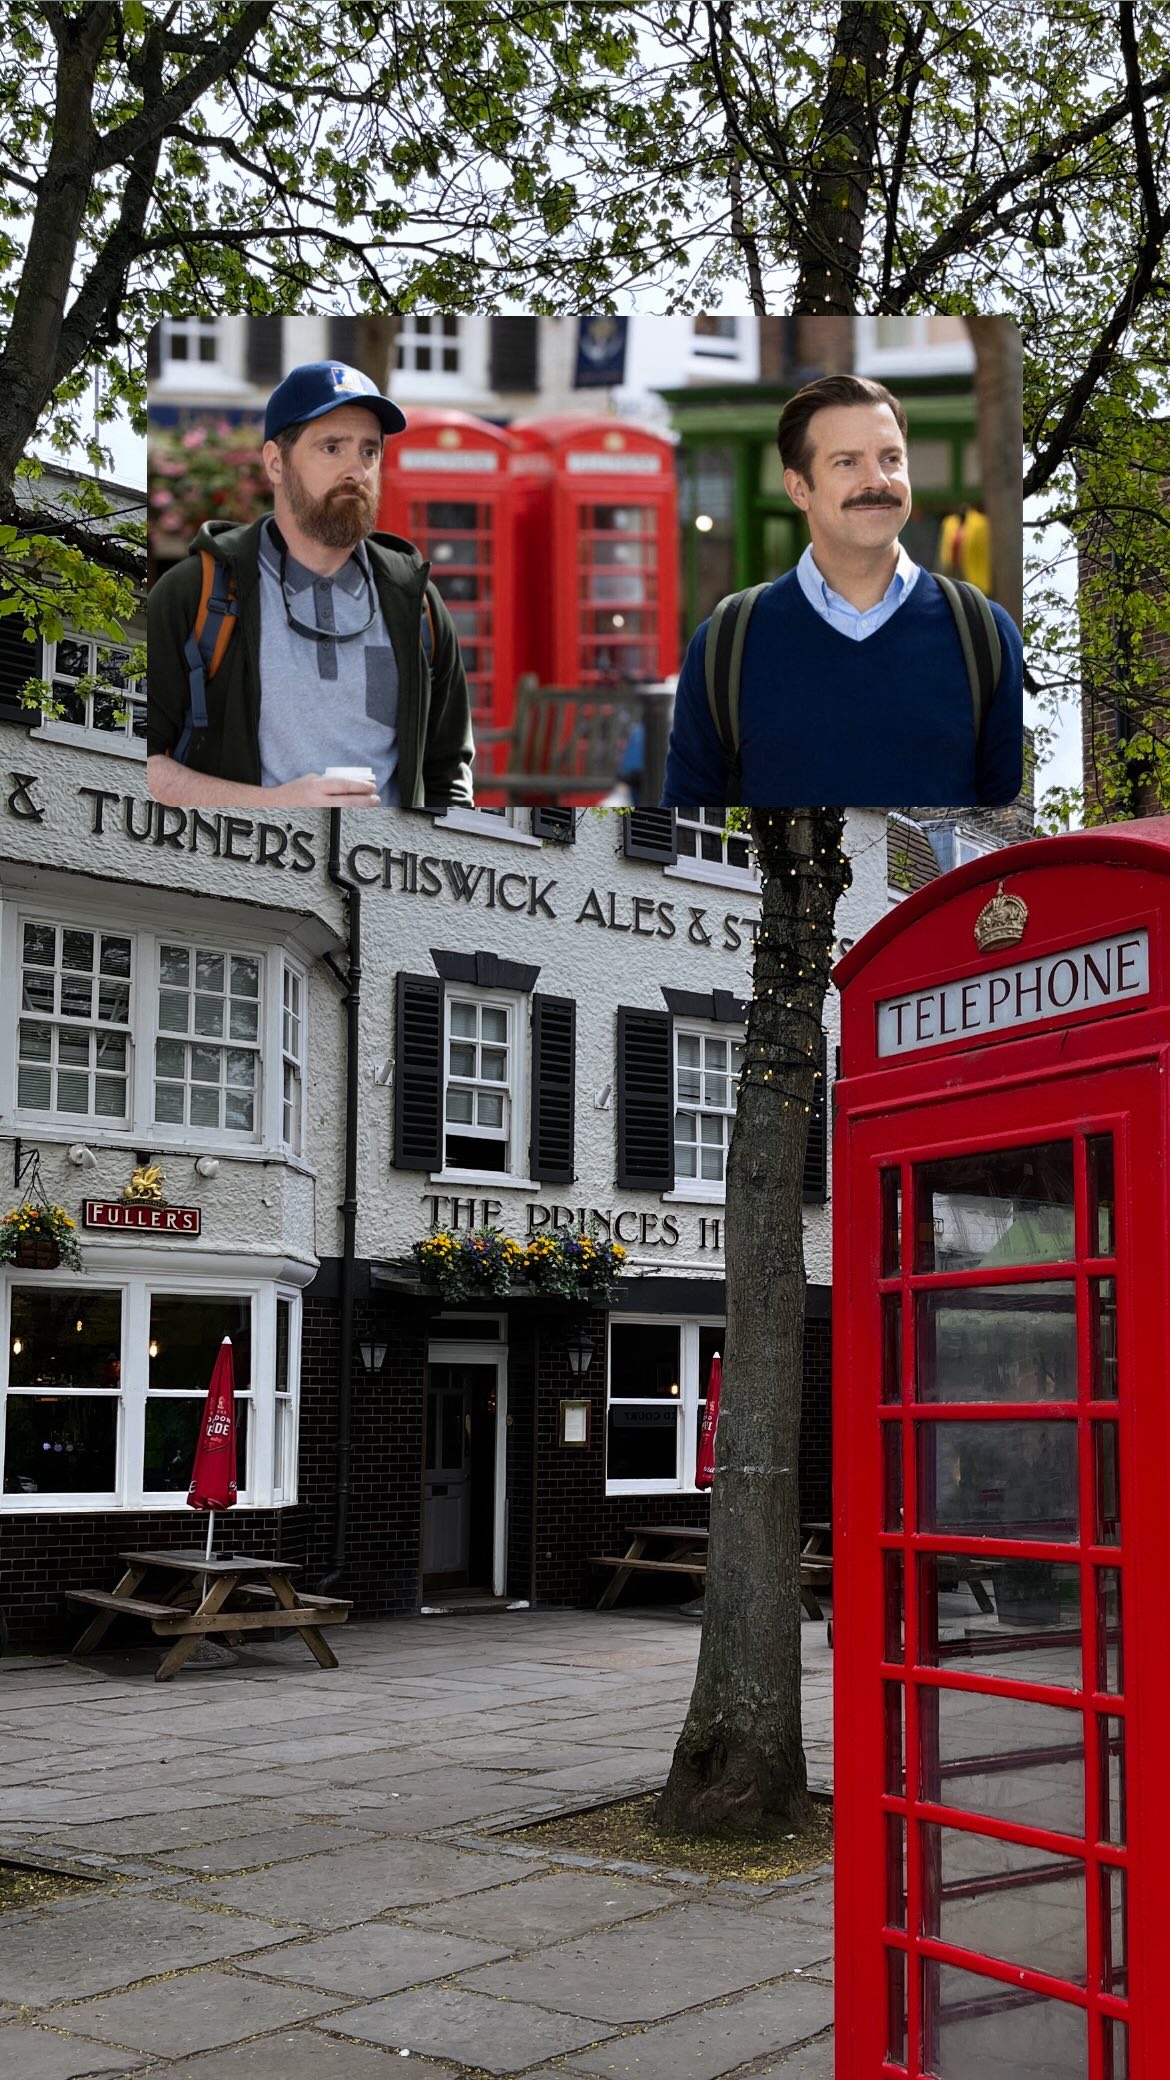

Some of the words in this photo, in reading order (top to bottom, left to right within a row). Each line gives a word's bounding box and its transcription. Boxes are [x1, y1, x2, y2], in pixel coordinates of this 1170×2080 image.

[8, 772, 45, 824] &
[78, 786, 316, 873] TURNER'S
[346, 843, 558, 919] CHISWICK
[575, 887, 677, 940] ALES
[688, 907, 713, 947] &
[888, 940, 1142, 1046] TELEPHONE
[92, 1203, 193, 1230] FULLER'S
[421, 1194, 505, 1234] THE
[525, 1203, 680, 1247] PRINCES
